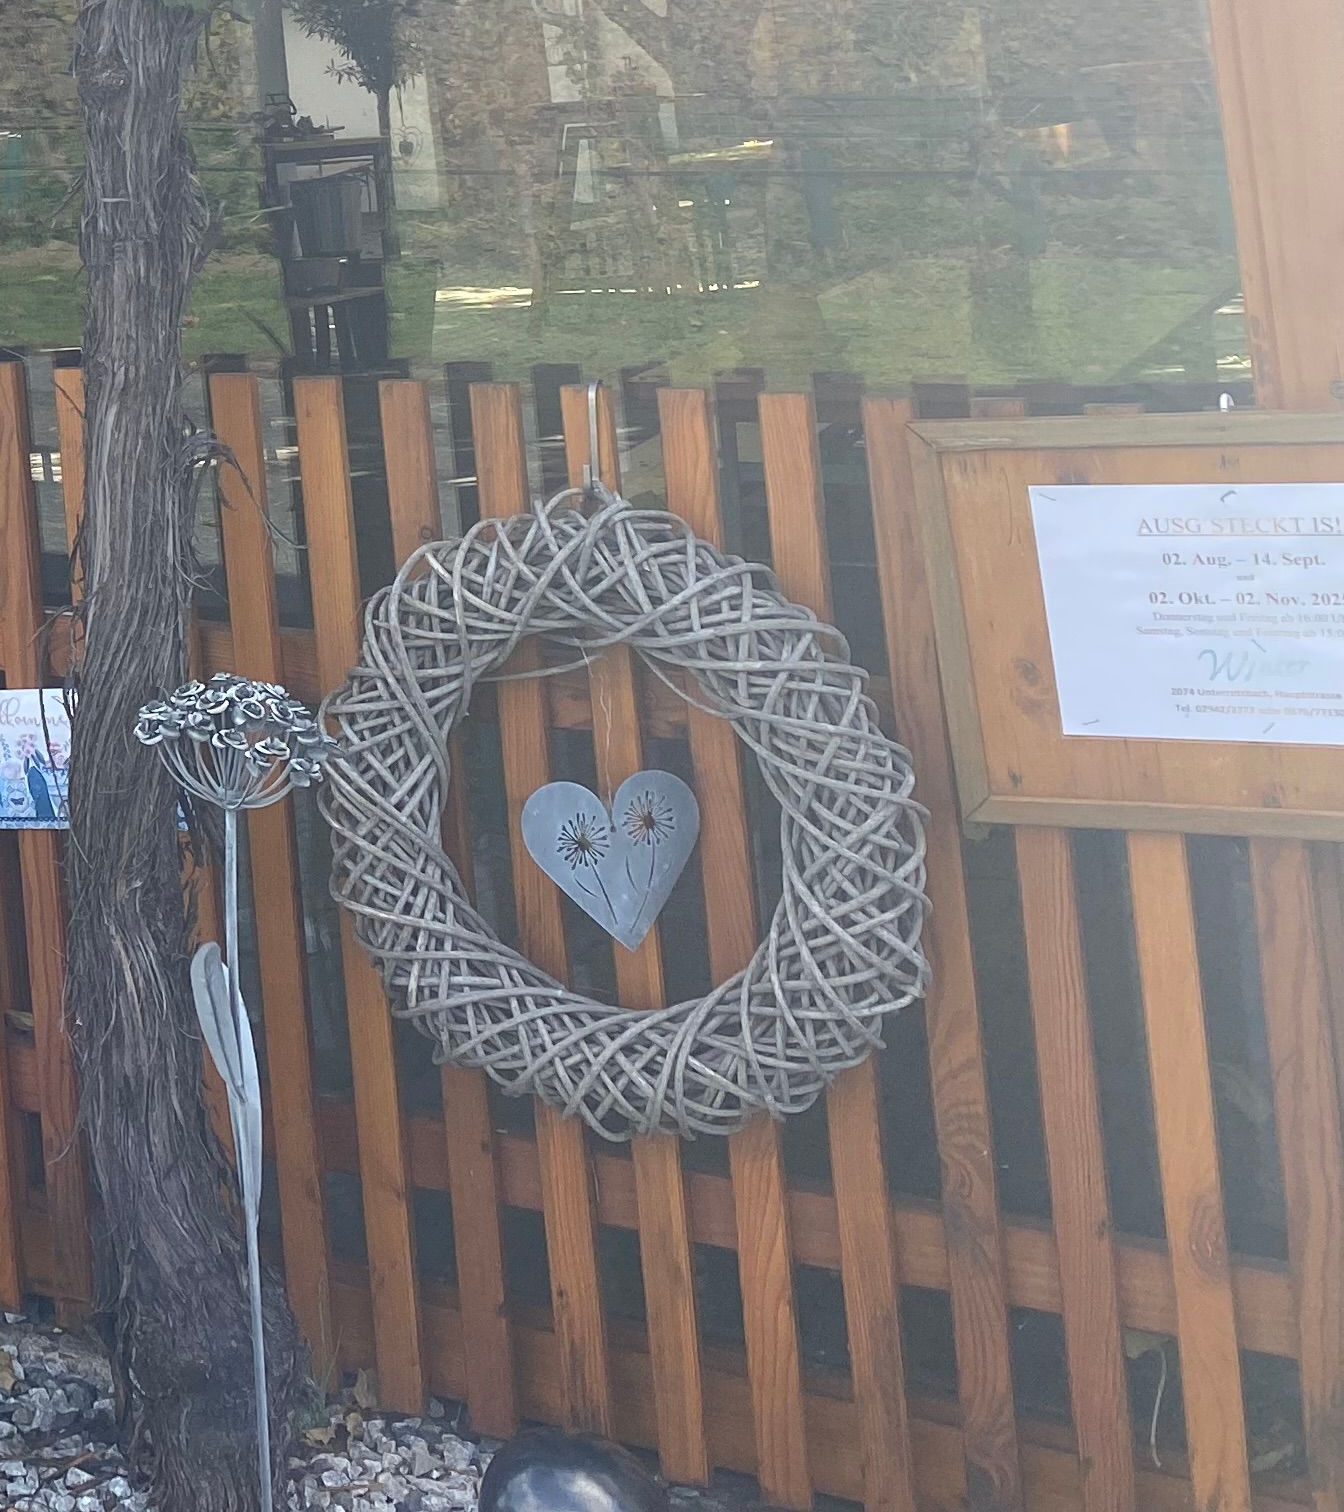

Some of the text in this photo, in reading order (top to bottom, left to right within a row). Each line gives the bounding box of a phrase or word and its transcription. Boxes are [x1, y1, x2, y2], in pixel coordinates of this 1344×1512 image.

[1212, 517, 1304, 535] STECKT
[1312, 516, 1342, 535] IS!
[1162, 553, 1187, 566] 02.
[1192, 553, 1232, 568] Aug.
[1253, 553, 1277, 566] 14.
[1281, 552, 1326, 569] Sept.
[1149, 592, 1174, 605] 02.
[1178, 591, 1216, 605] Okt.
[1236, 592, 1261, 605] 02.
[1266, 592, 1306, 606] Nov.
